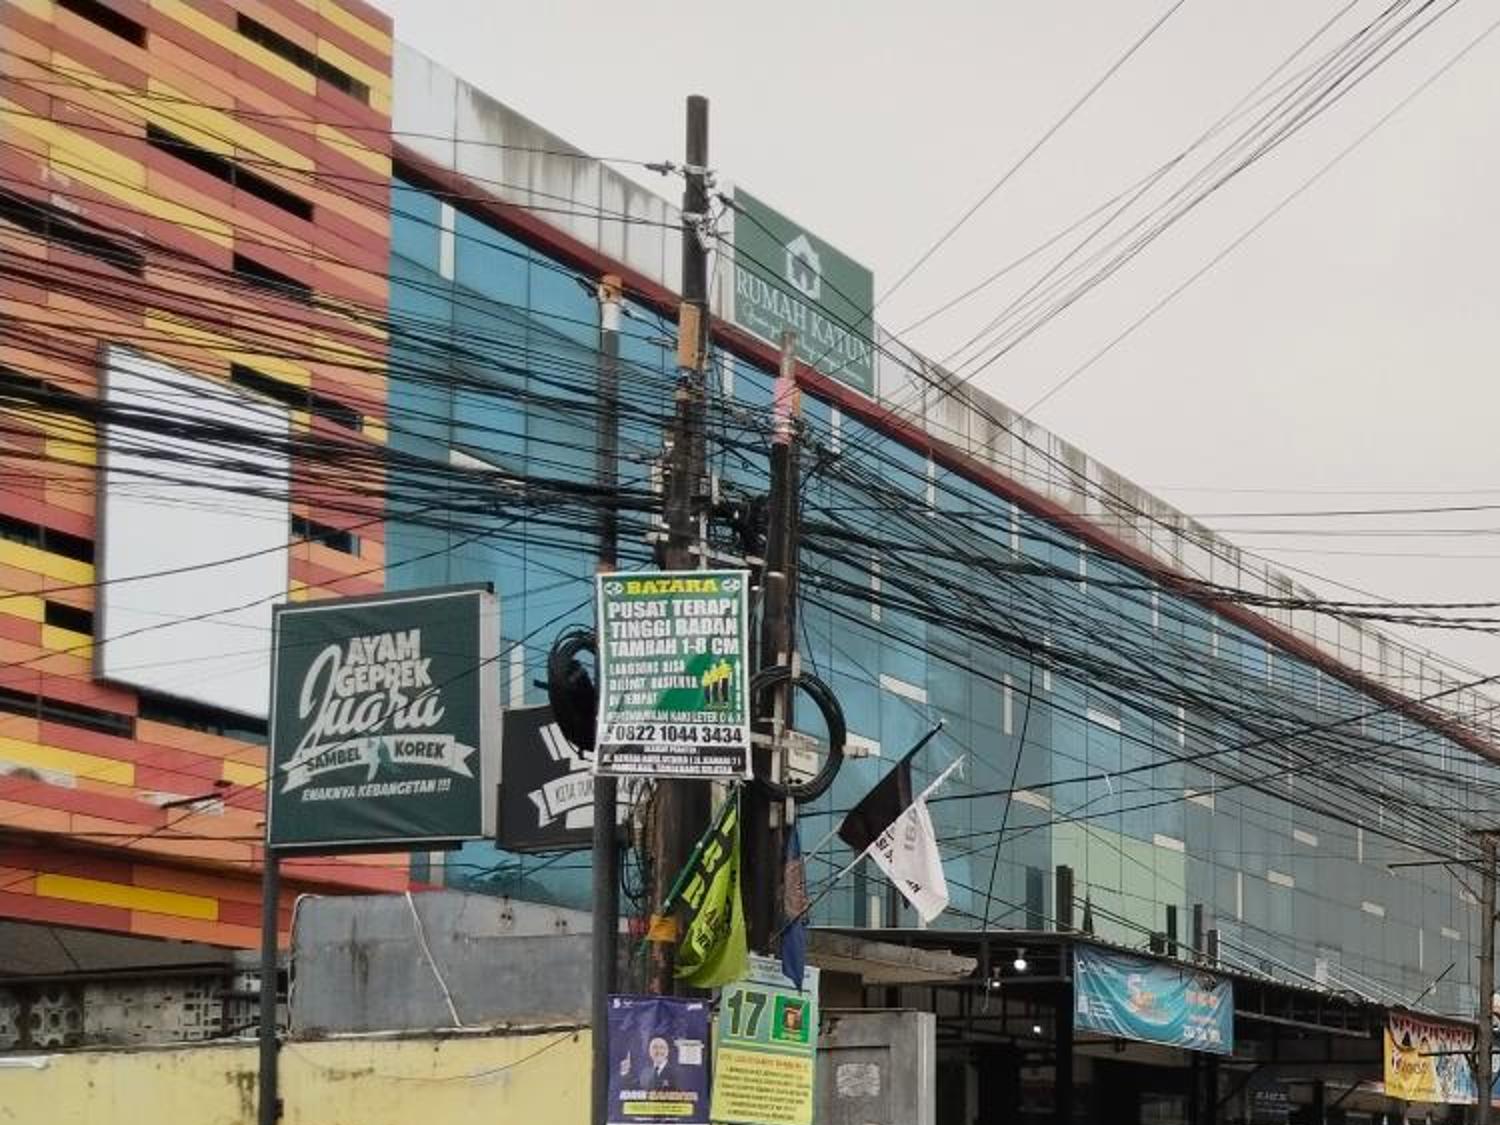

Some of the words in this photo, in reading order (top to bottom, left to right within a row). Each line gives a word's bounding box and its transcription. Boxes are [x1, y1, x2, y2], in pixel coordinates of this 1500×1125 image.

[626, 579, 719, 595] BATARA
[608, 600, 669, 619] PUSAT
[672, 598, 739, 617] TERAPI
[609, 619, 671, 639] TINGGI
[675, 617, 737, 636] BADAN
[347, 628, 422, 666] AYAM
[609, 637, 677, 657] TAMBAH
[711, 637, 740, 655] CM
[335, 657, 432, 698] GEPREK
[291, 643, 446, 762] Juara
[615, 725, 656, 742] 0822
[659, 725, 698, 743] 1044
[702, 727, 744, 744] 3434
[306, 747, 362, 772] SAMBEL
[394, 740, 447, 759] KOREK
[357, 779, 436, 798] KEBANGETAN
[726, 989, 769, 1037] 17
